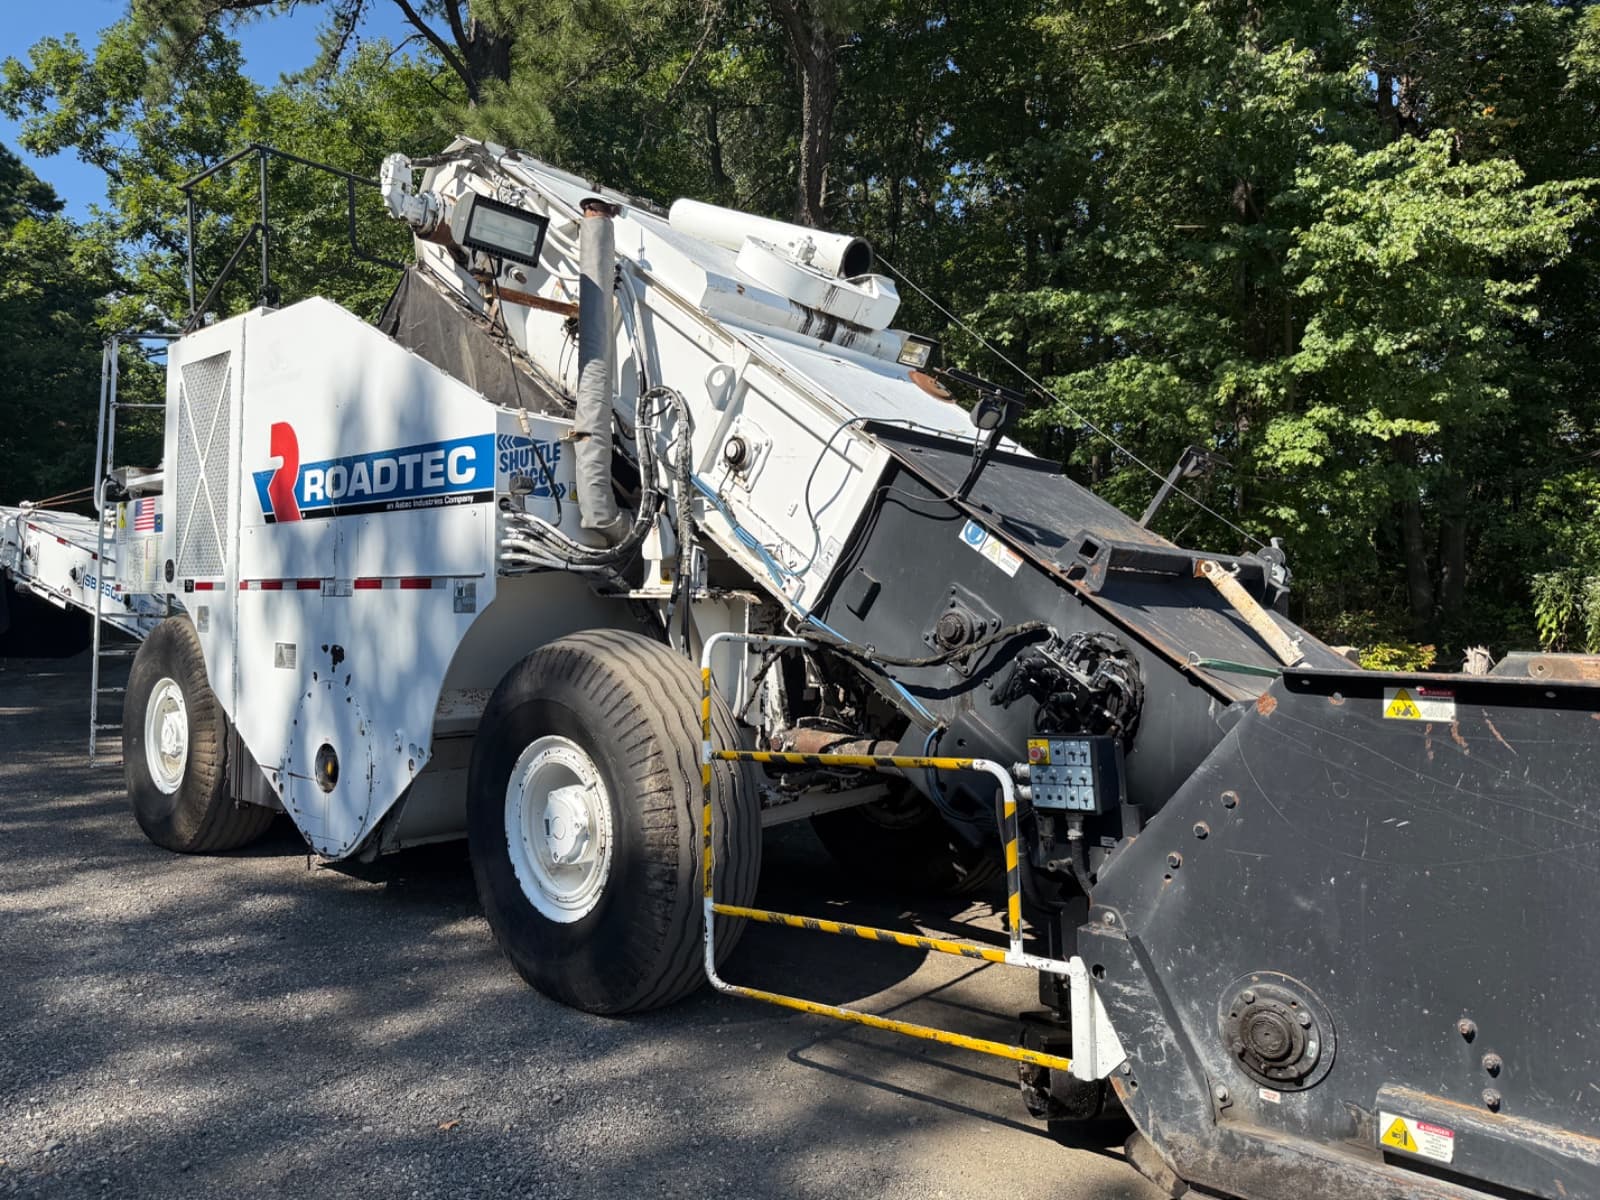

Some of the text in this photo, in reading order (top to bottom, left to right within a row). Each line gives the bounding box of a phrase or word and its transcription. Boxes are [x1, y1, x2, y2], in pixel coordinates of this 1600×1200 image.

[499, 442, 561, 473] SHUTTLE
[303, 445, 476, 503] ROADTEC
[444, 494, 474, 505] Company
